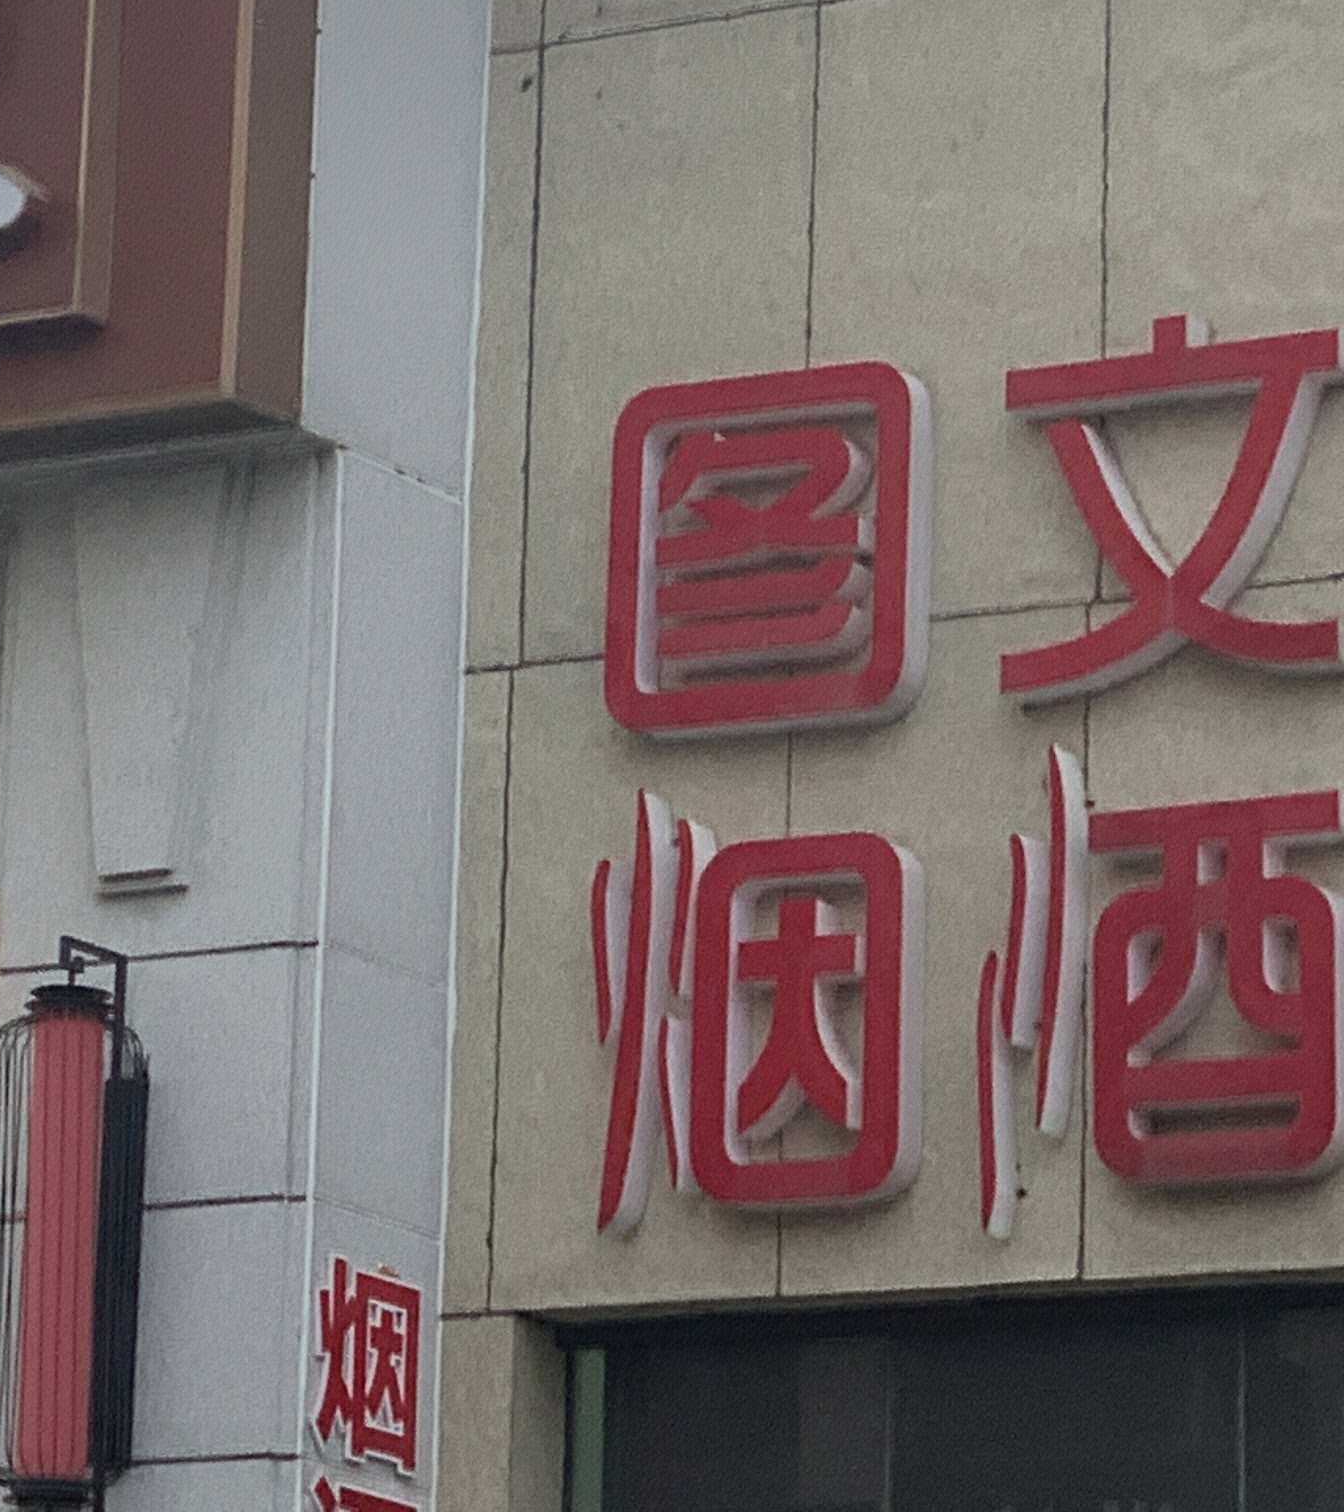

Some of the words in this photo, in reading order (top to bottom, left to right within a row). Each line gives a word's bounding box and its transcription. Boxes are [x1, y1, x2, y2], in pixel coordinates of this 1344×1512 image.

[603, 314, 1342, 732] 图文
[591, 743, 1342, 1238] 烟酒
[313, 1255, 420, 1512] 烟
